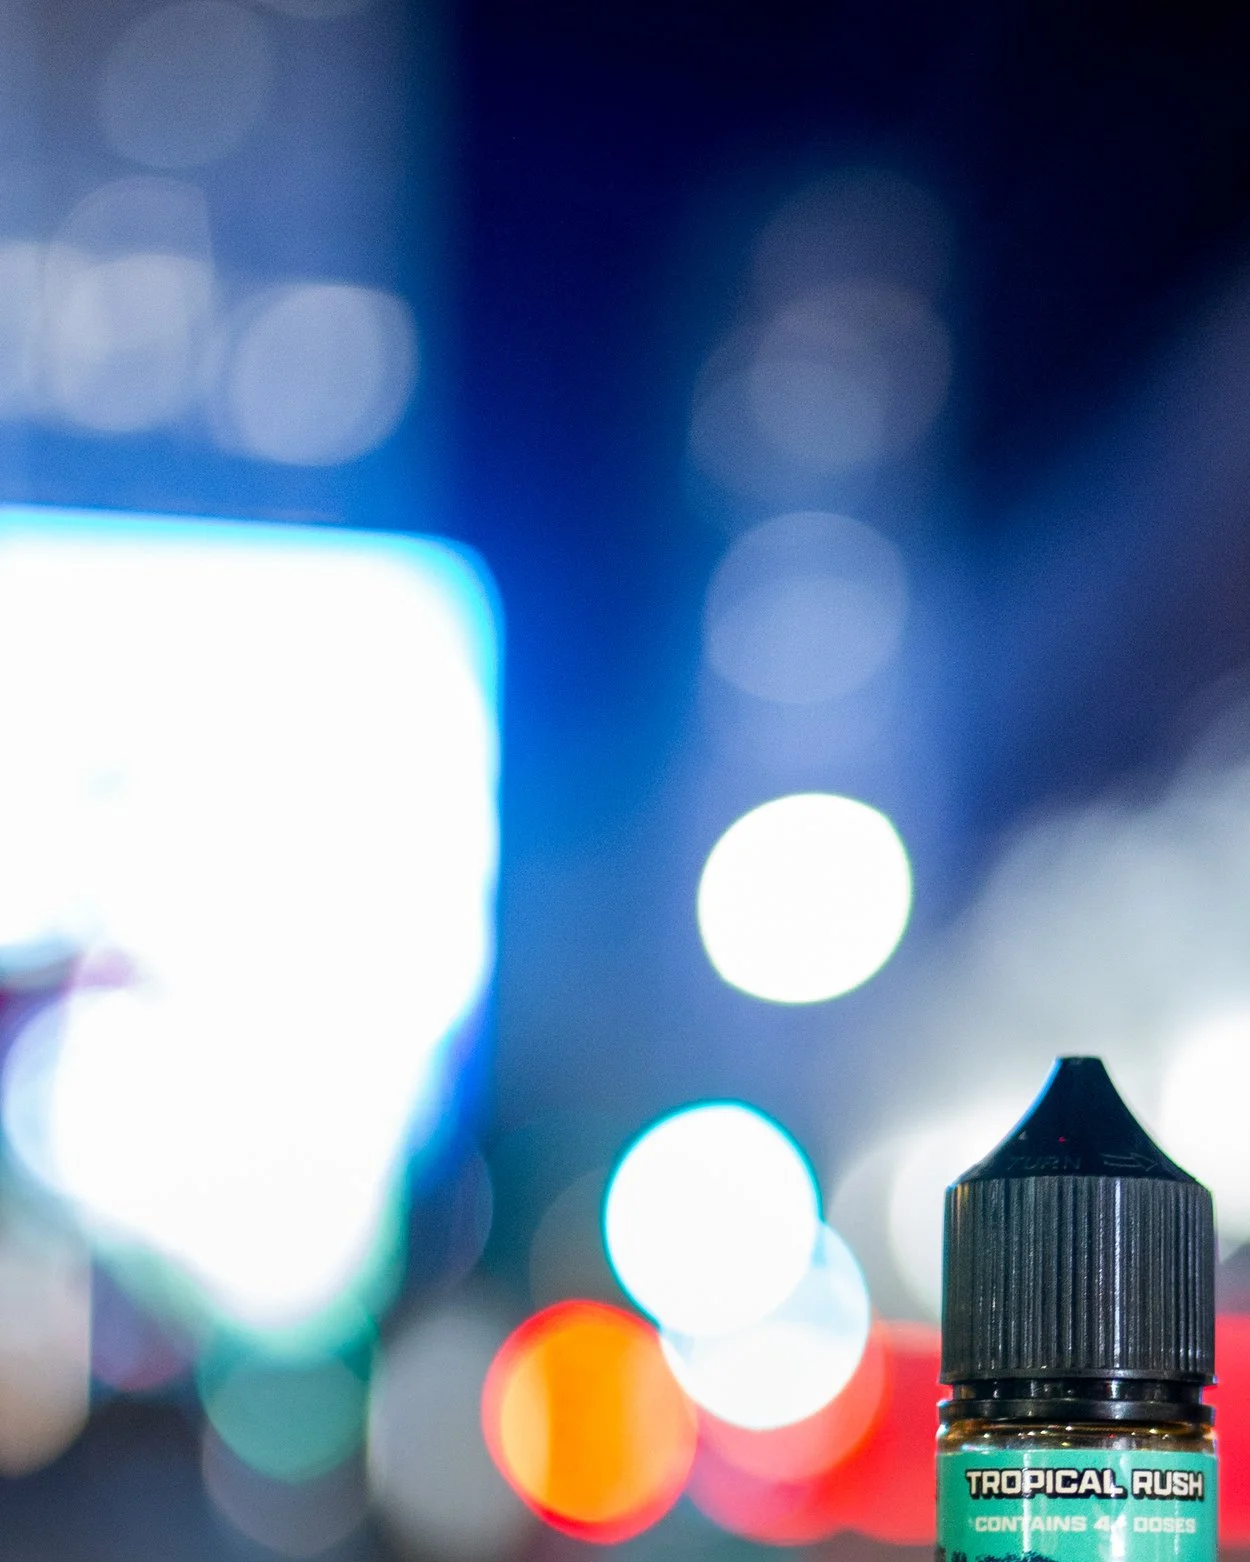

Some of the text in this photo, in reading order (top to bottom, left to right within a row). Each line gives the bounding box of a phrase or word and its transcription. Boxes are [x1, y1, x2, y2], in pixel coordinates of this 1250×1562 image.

[966, 1468, 1205, 1501] TROPICAL RUSH
[975, 1515, 1087, 1534] CONTAINS
[1133, 1515, 1197, 1535] DOSES
